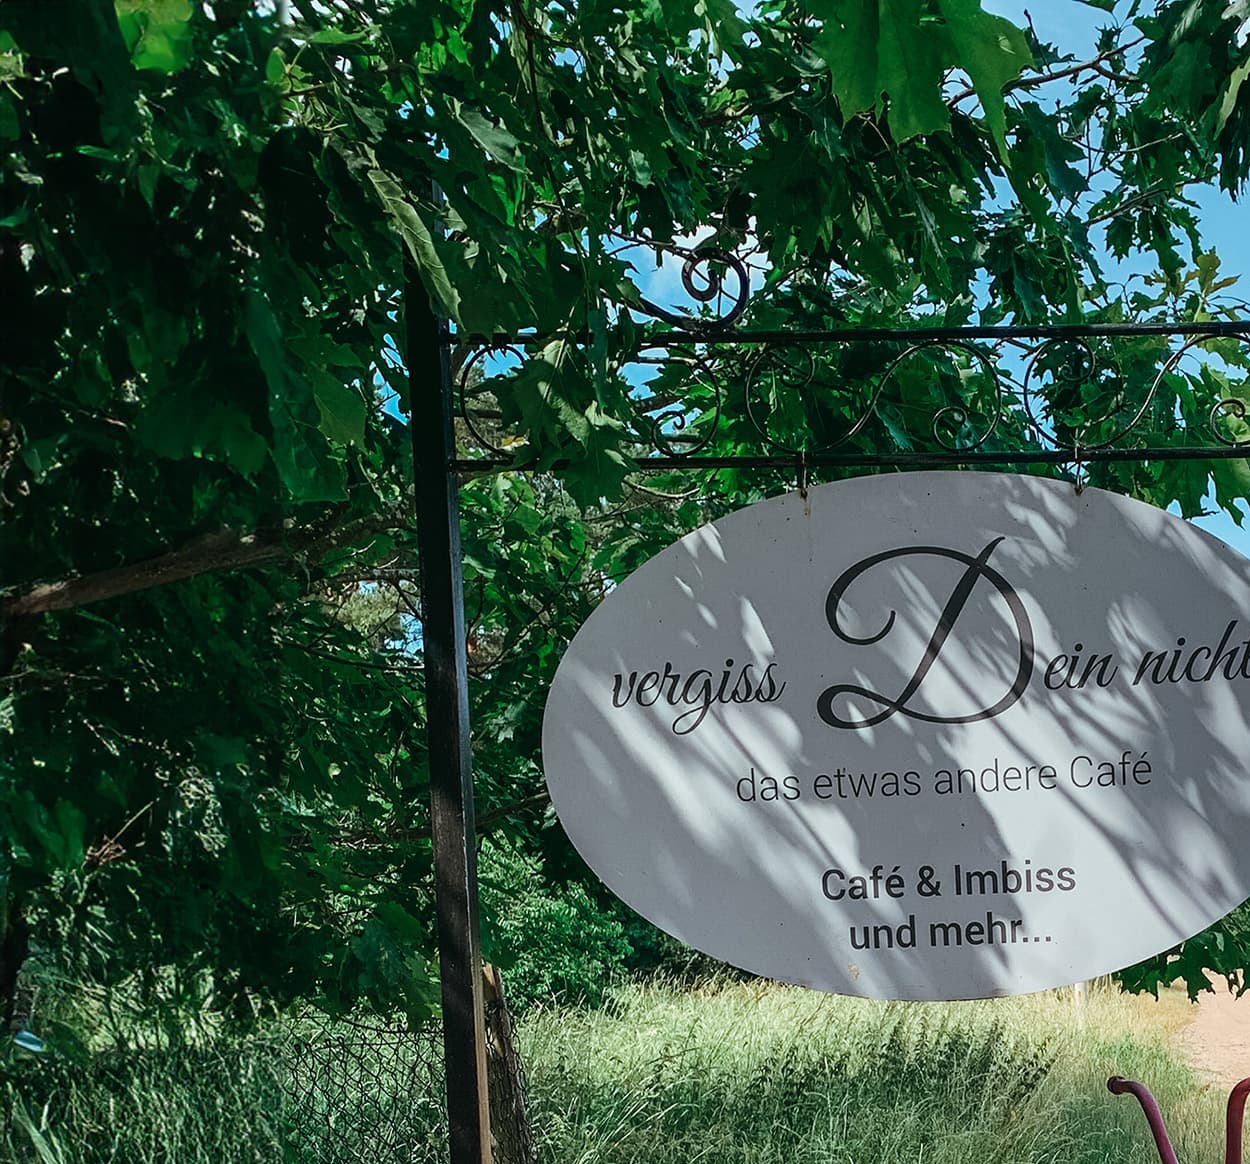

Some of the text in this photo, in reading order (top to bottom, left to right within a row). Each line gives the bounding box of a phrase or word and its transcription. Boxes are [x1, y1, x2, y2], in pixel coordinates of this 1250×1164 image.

[611, 657, 786, 735] vergiss
[736, 752, 1152, 802] das etwas andere Café
[821, 861, 1076, 901] Café & Imbiss
[849, 911, 1052, 950] und mehr...
